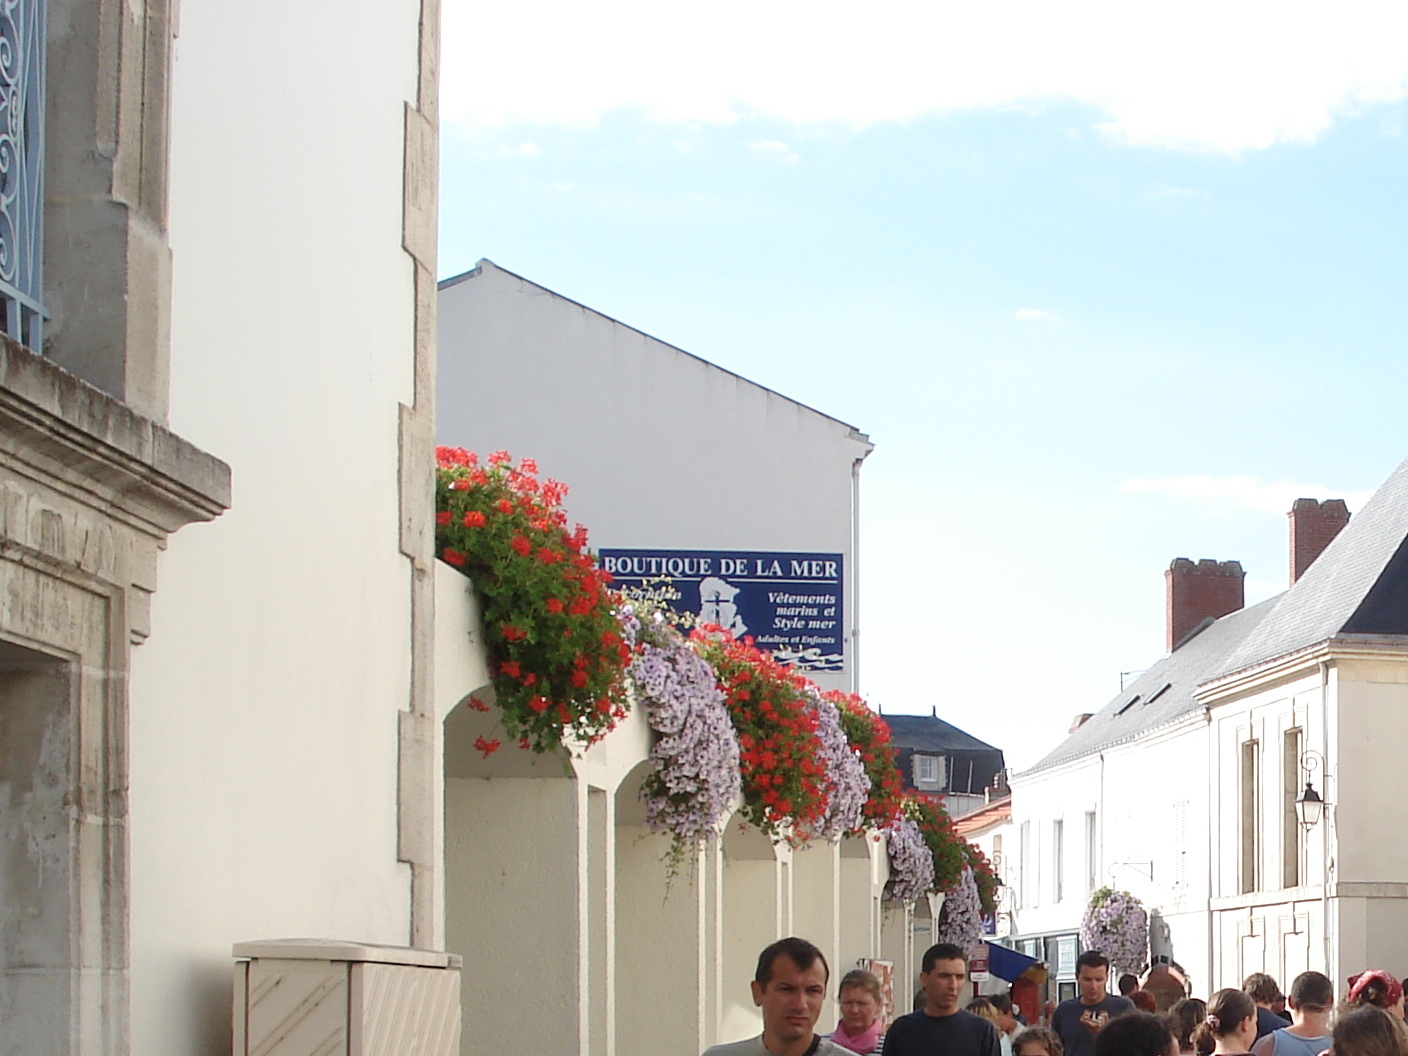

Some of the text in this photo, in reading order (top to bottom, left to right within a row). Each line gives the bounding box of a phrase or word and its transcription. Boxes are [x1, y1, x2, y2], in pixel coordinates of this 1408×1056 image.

[604, 556, 838, 578] BOUTIQUE DE LA MER
[768, 592, 836, 604] Vêtements
[776, 605, 836, 617] marins et
[772, 617, 836, 631] Style mer
[790, 635, 800, 643] et
[801, 635, 835, 645] Enfants
